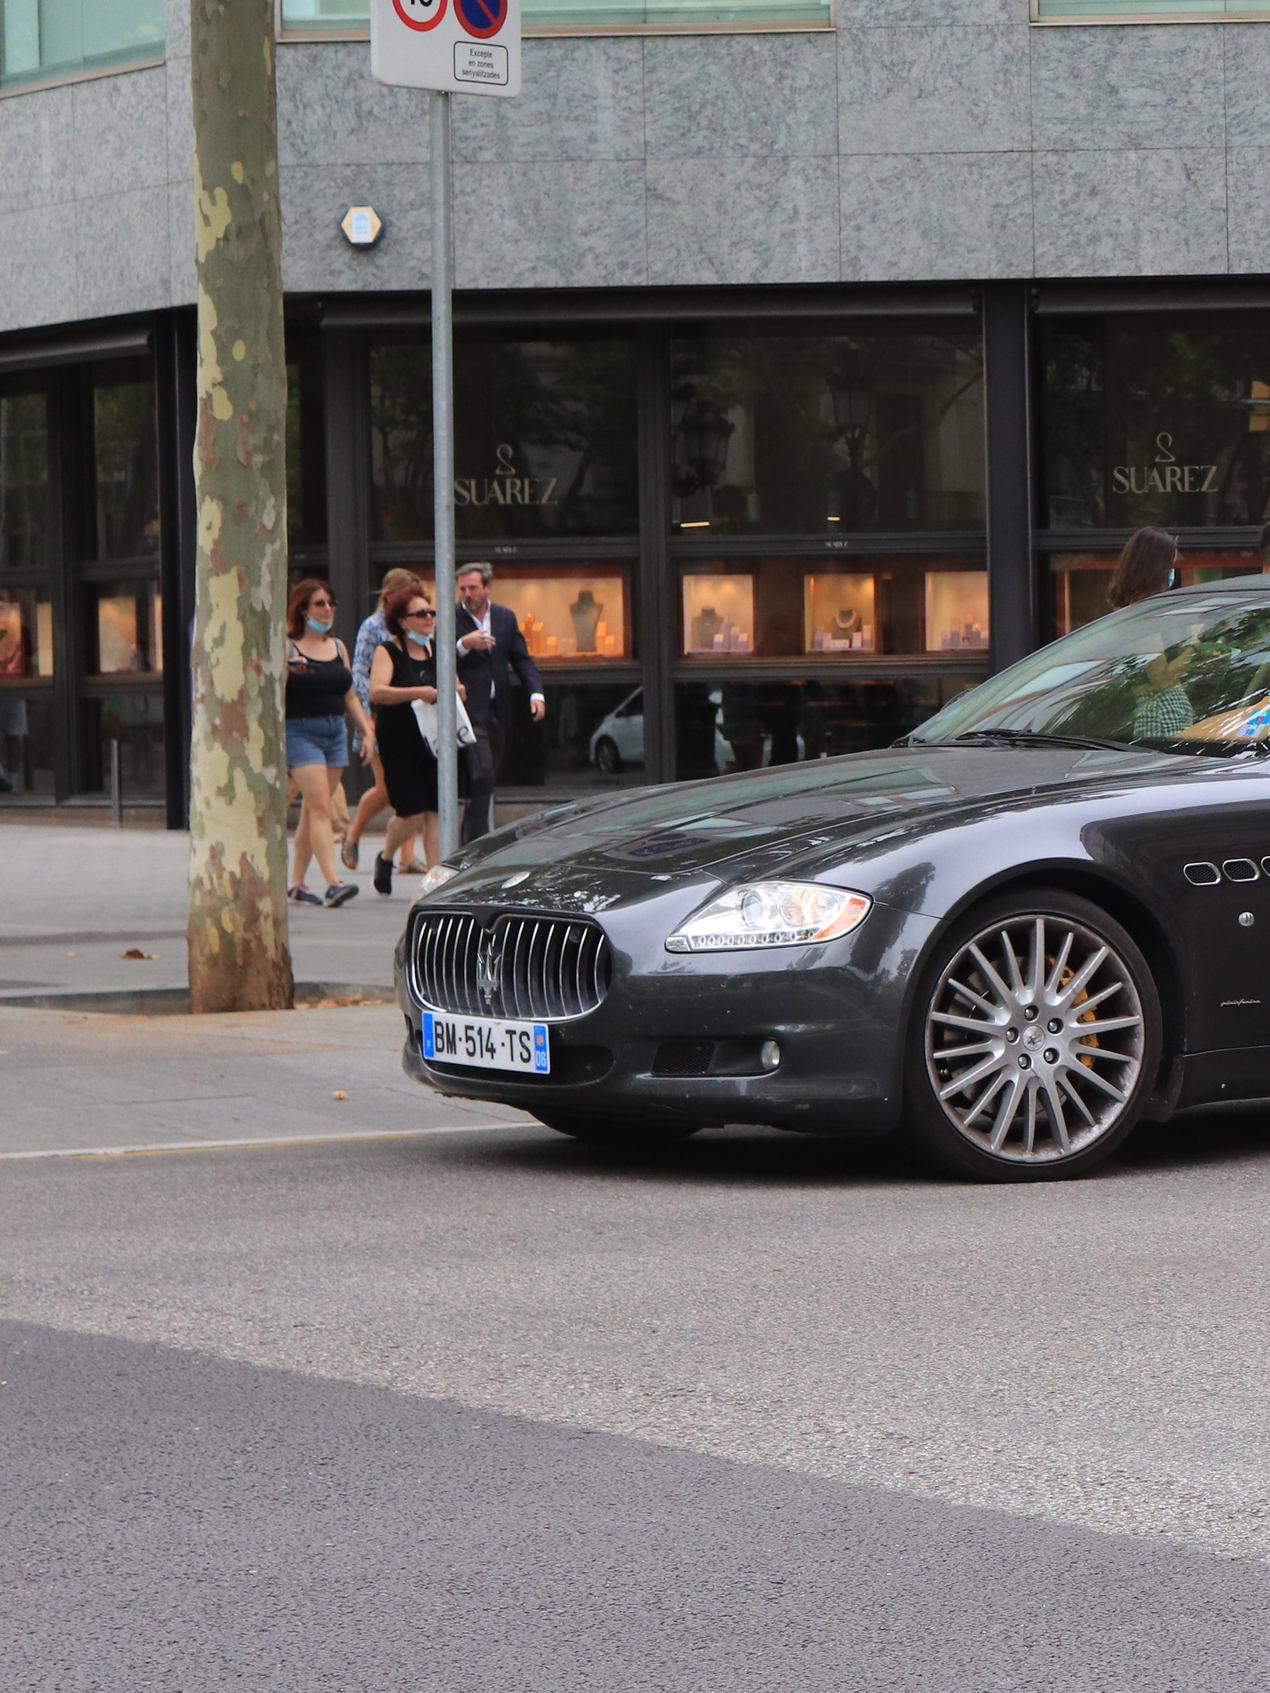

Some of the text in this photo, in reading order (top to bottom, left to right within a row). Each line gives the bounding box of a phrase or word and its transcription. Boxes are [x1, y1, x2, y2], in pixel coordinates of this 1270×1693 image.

[469, 48, 493, 59] Excepte
[477, 61, 494, 69] zones
[462, 69, 500, 79] senyalitzades
[1112, 465, 1219, 494] SUAREZ
[453, 477, 558, 506] SUAREZ
[535, 1050, 547, 1068] 06
